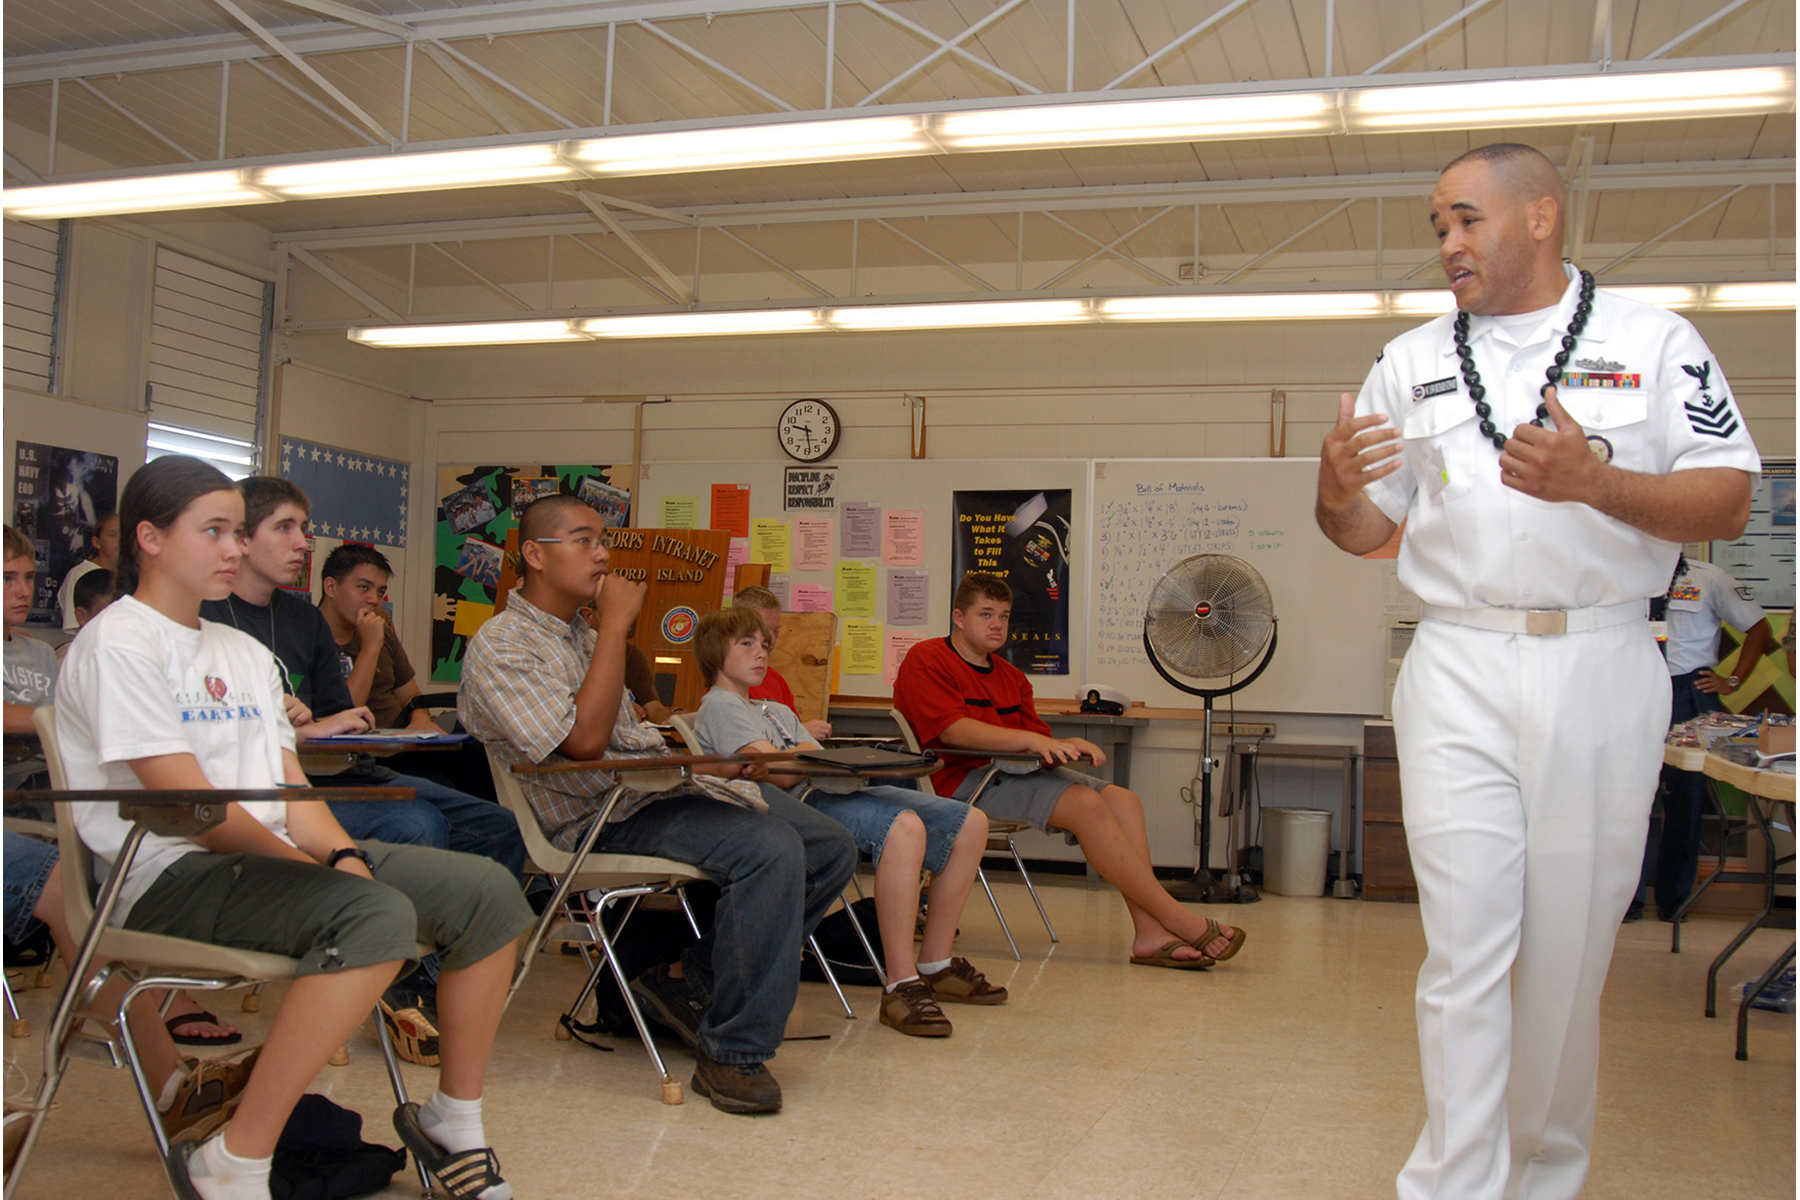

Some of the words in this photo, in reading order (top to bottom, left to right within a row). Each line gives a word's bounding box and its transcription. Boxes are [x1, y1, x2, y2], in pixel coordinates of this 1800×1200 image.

[795, 408, 802, 416] 11
[804, 405, 813, 413] 12
[787, 416, 797, 424] 10
[822, 416, 828, 424] 2
[784, 426, 791, 434] 9
[825, 426, 831, 434] 3
[787, 437, 794, 445] 8
[795, 445, 801, 453] 7
[803, 447, 811, 456] 6
[814, 445, 820, 453] 5
[19, 448, 37, 461] U.S.
[18, 465, 40, 479] NAVY
[788, 472, 821, 482] DISCIPLINE
[18, 482, 35, 495] EOD
[788, 485, 814, 495] RESPECT
[1136, 483, 1152, 493] Bill
[1154, 482, 1164, 492] of
[1168, 482, 1205, 492] Materials
[788, 497, 835, 508] RESPONSIBILITY
[959, 514, 972, 522] Do
[975, 514, 992, 522] You
[994, 514, 1018, 522] Have
[971, 525, 996, 533] What
[997, 525, 1006, 533] It
[974, 536, 1002, 545] Takes
[651, 534, 720, 570] INTRANET
[974, 548, 985, 556] to
[986, 547, 1002, 556] Fill
[978, 558, 998, 567] This
[613, 567, 647, 581] FORD
[656, 568, 704, 582] ISLAND
[46, 577, 58, 588] Do
[39, 586, 53, 597] the
[39, 598, 48, 608] of
[1012, 632, 1061, 641] SEALS
[3, 664, 51, 697] LISTER
